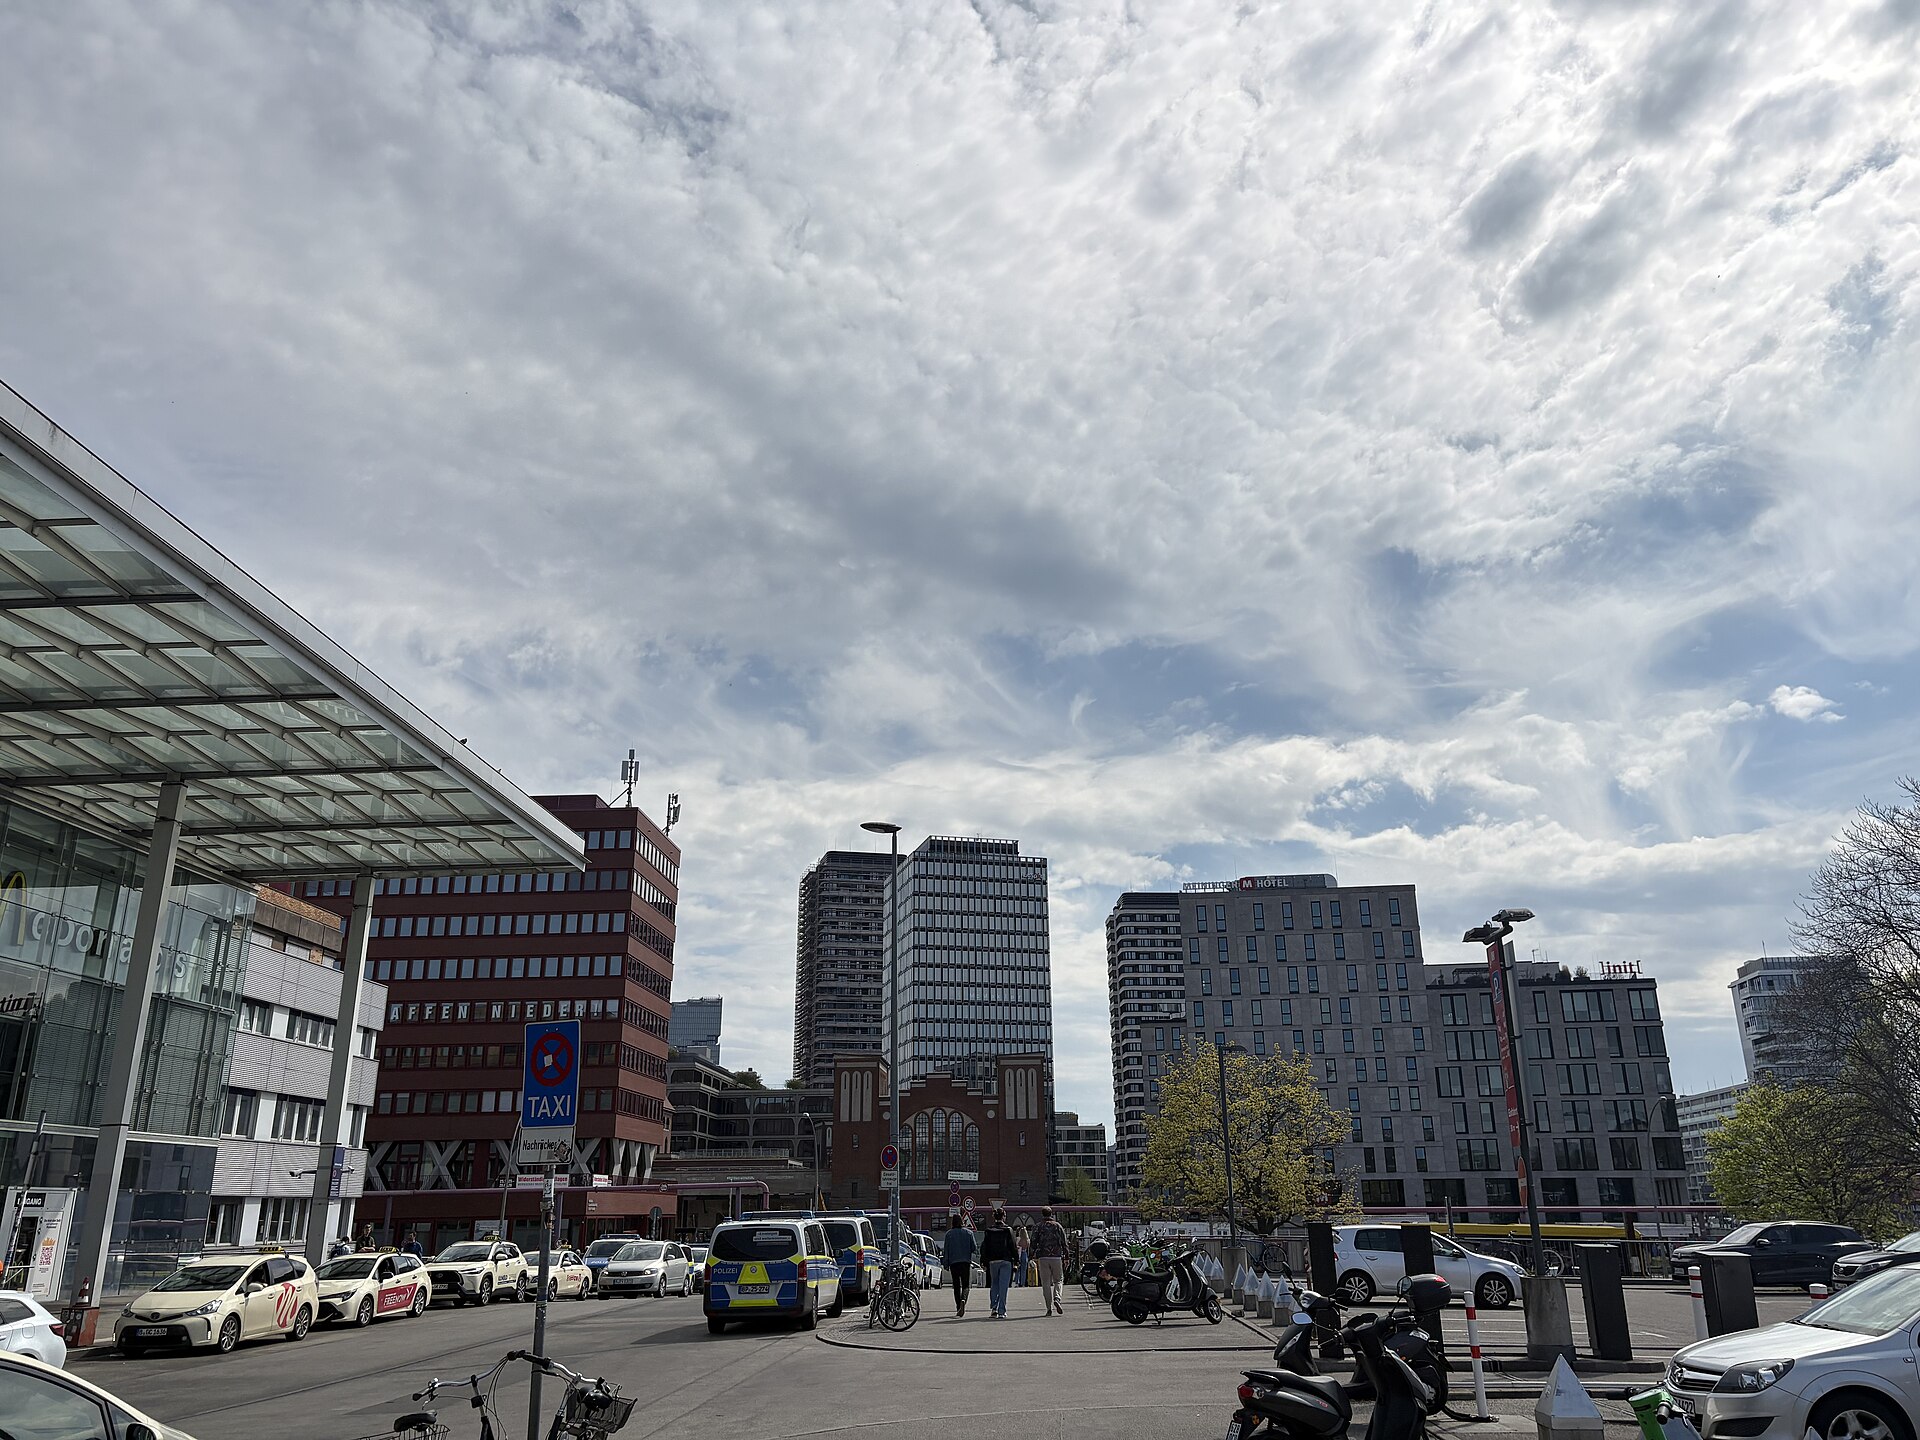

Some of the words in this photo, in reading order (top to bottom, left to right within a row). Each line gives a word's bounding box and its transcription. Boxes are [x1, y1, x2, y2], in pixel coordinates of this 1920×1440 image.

[1256, 879, 1289, 887] HOTEL
[491, 1002, 599, 1017] NIEDER!
[527, 1094, 572, 1118] TAXI
